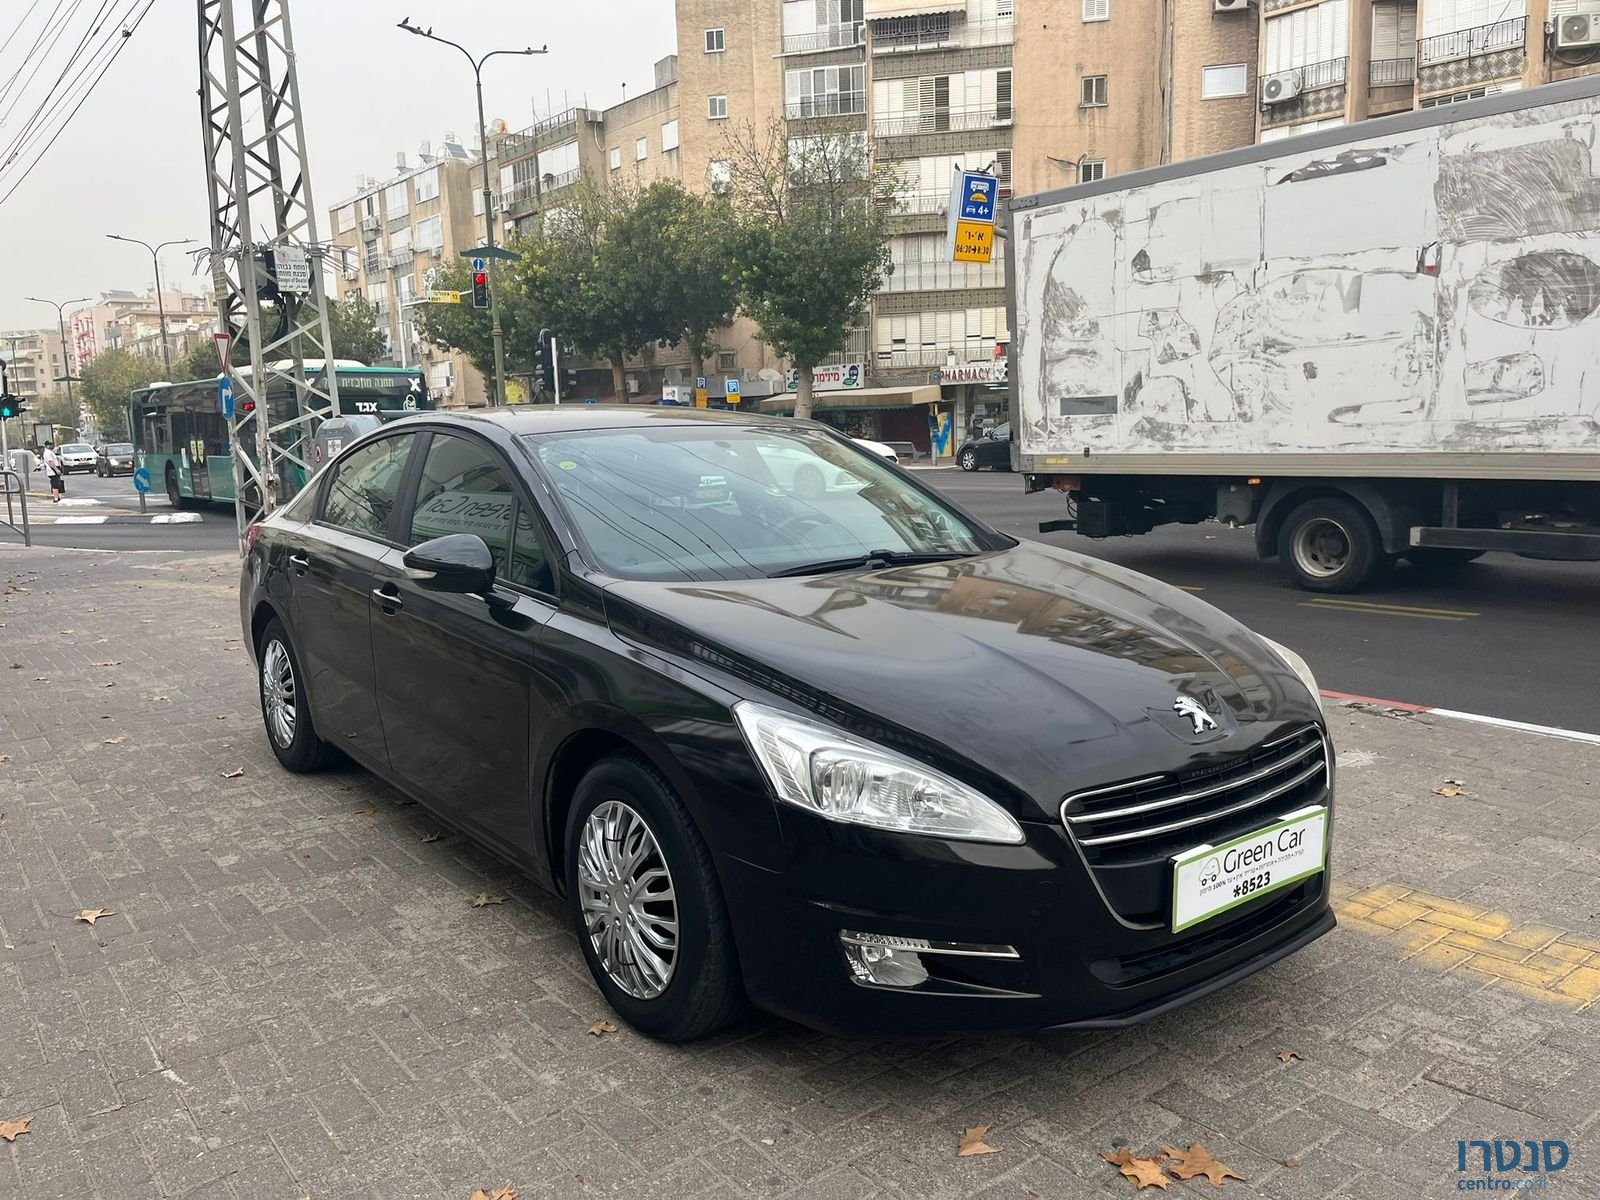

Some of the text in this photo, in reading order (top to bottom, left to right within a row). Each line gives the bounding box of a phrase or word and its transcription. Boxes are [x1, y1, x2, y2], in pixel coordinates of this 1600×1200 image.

[977, 205, 989, 216] 4+
[940, 367, 991, 382] PHARMACY
[1224, 828, 1306, 873] Green Car
[1213, 879, 1226, 890] 100%
